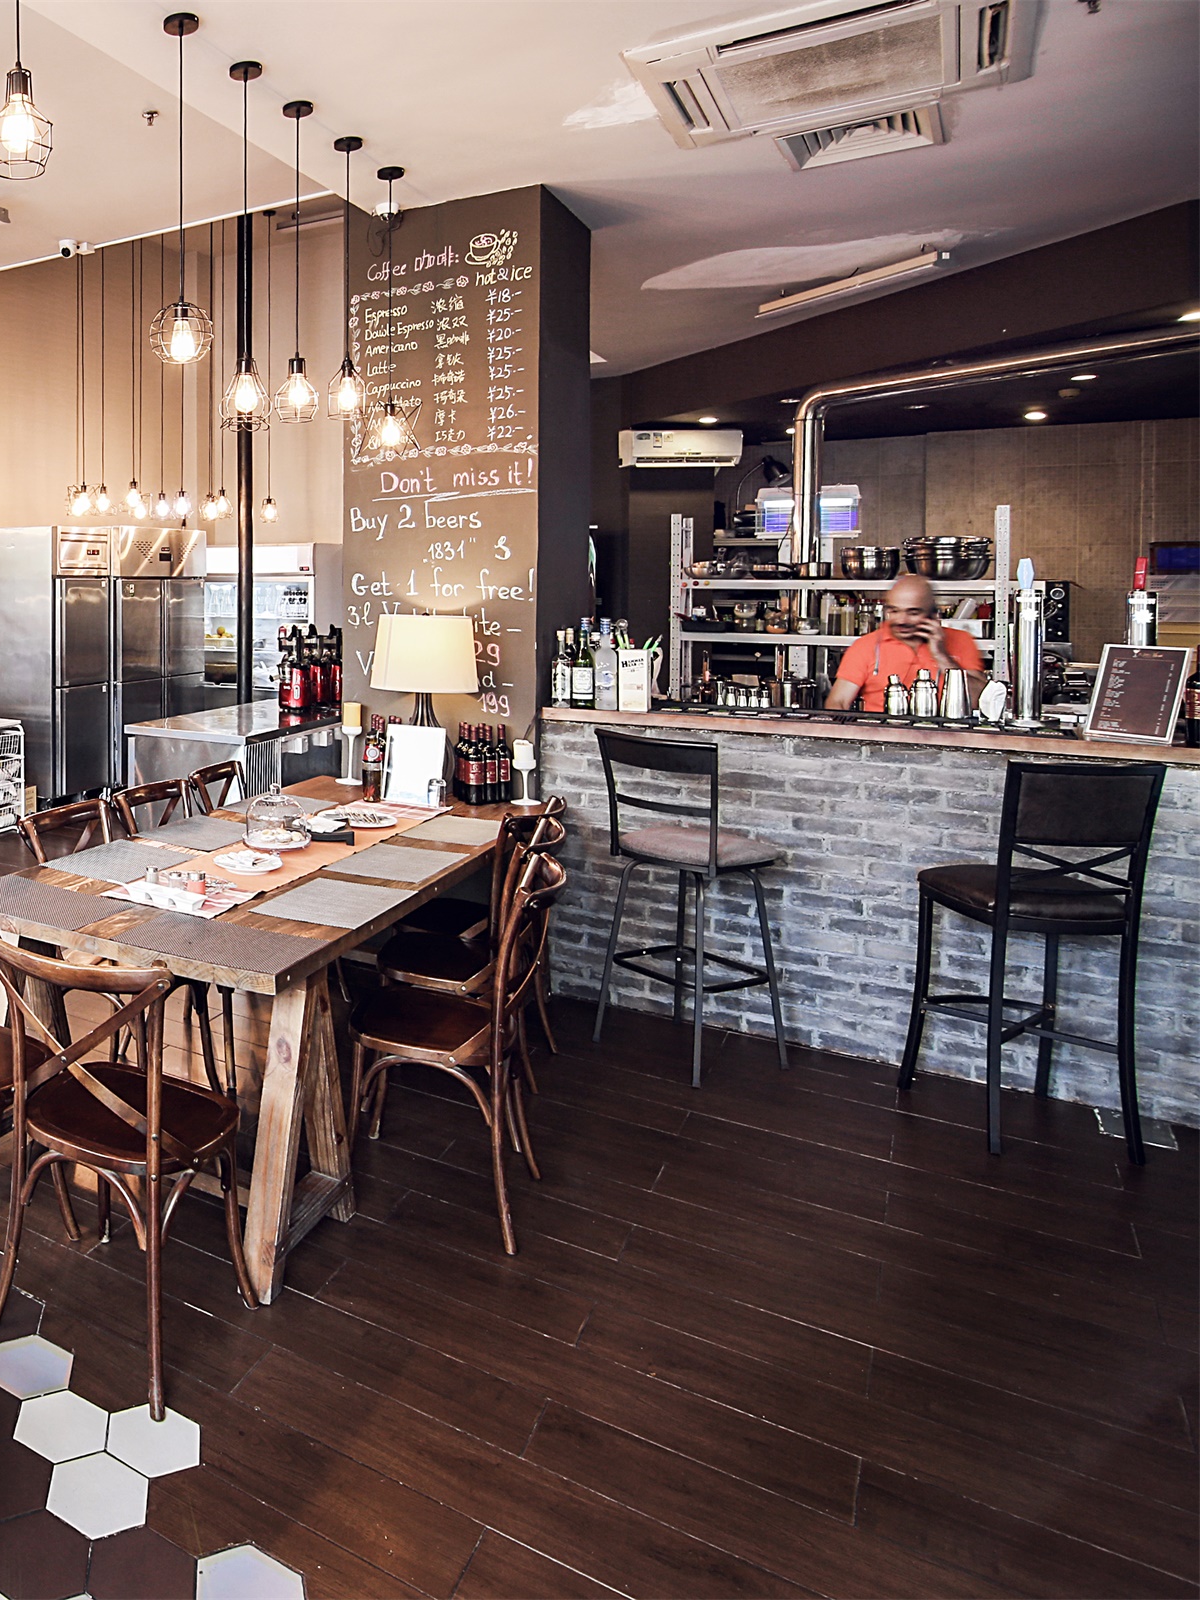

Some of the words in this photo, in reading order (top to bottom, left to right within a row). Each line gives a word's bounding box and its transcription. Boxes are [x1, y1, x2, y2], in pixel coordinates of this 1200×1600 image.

[367, 261, 407, 282] Coffee
[365, 305, 408, 325] Espresso
[397, 319, 434, 339] Espresso
[365, 341, 418, 357] Americano
[367, 360, 396, 377] Latte
[366, 379, 421, 398] Cappuccino
[381, 467, 437, 493] Don't
[453, 468, 500, 487] miss
[508, 458, 533, 486] it!
[350, 507, 388, 540] Buy
[398, 504, 416, 528] 2
[425, 501, 482, 528] beers
[351, 571, 393, 596] Get
[406, 569, 419, 596] 1
[430, 567, 464, 597] for
[476, 568, 535, 601] free!
[477, 693, 510, 717] 199
